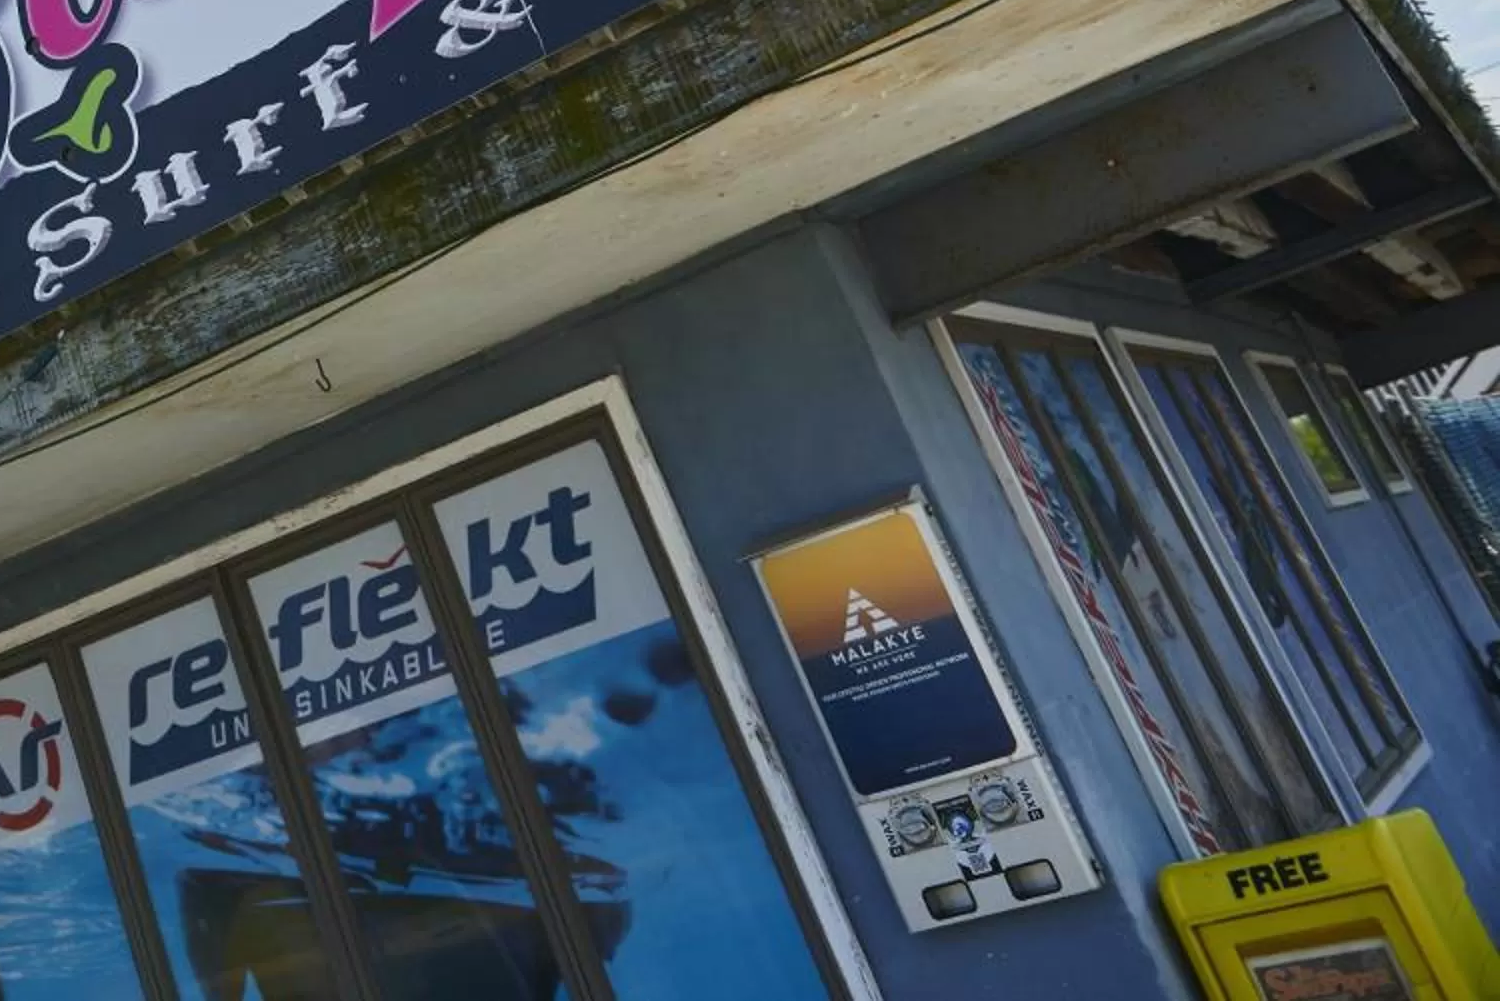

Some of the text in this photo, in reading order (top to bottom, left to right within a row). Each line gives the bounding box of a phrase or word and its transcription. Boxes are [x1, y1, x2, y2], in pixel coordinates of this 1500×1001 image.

[26, 41, 369, 304] Surf
[831, 625, 926, 667] MALAKYE
[1017, 778, 1038, 810] WAX
[1225, 852, 1330, 899] FREE
